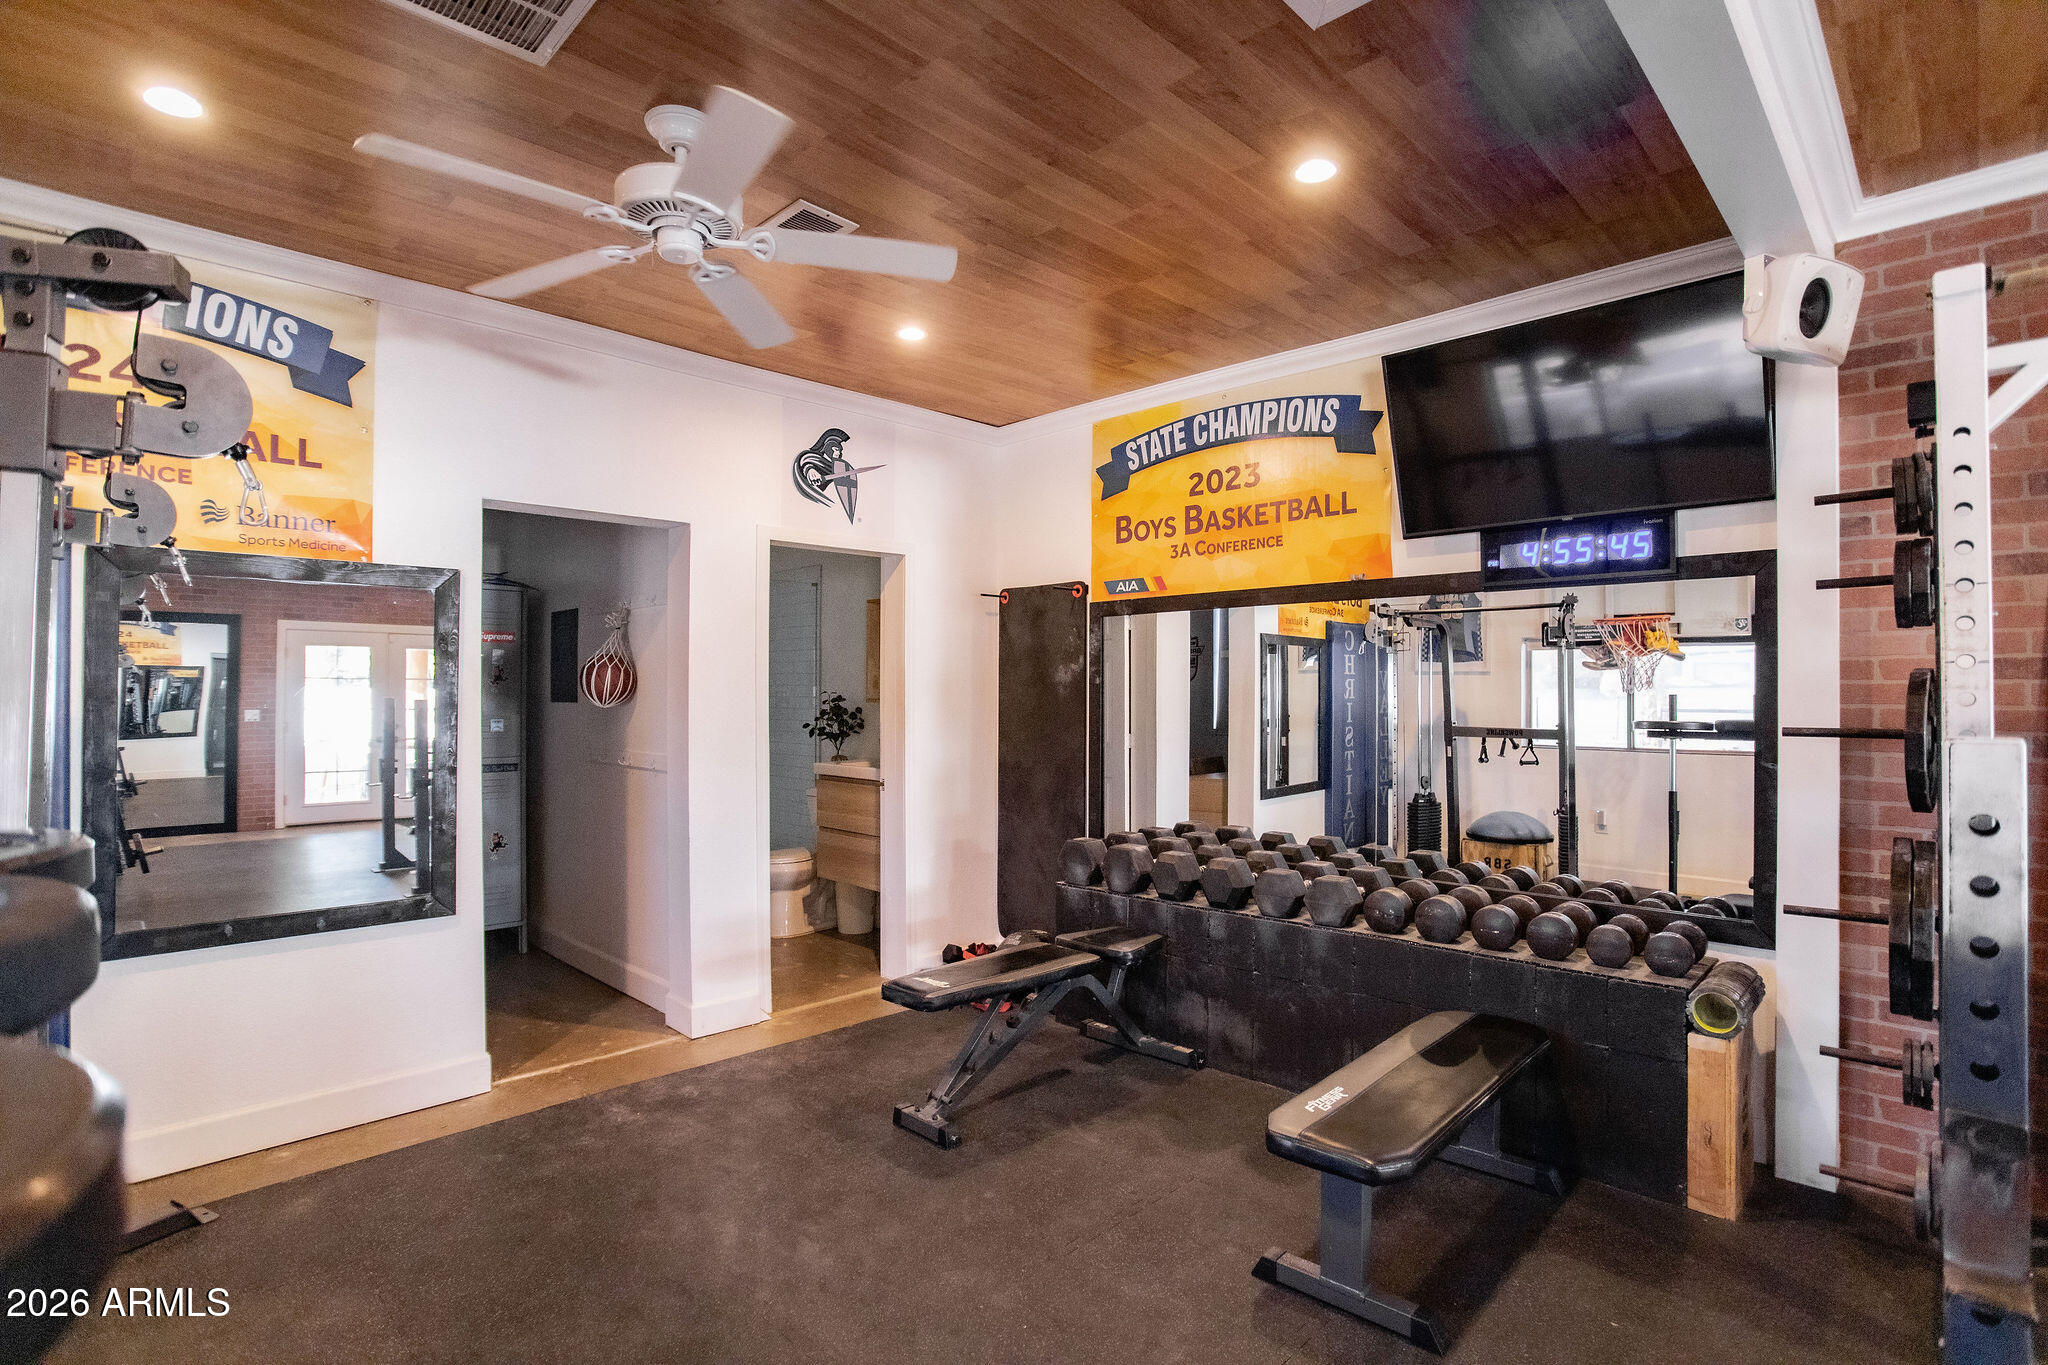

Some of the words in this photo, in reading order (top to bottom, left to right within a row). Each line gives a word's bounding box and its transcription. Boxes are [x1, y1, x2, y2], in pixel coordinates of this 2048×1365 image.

[185, 286, 299, 359] IONS
[64, 343, 143, 389] 24
[242, 431, 323, 469] ALL
[1125, 427, 1187, 471] STATE
[1192, 397, 1340, 446] CHAMPIONS
[65, 454, 193, 485] FERENCE
[1188, 462, 1261, 498] 2023
[236, 505, 336, 533] Banner
[1115, 514, 1177, 545] BOYS
[1184, 491, 1358, 535] BASKETBALL
[238, 533, 285, 547] Sports
[289, 537, 347, 552] Medicine
[1170, 545, 1191, 559] 3A
[1194, 535, 1284, 556] CONFERENCE
[1521, 530, 1651, 566] 4:55:45
[1115, 579, 1140, 593] AIA
